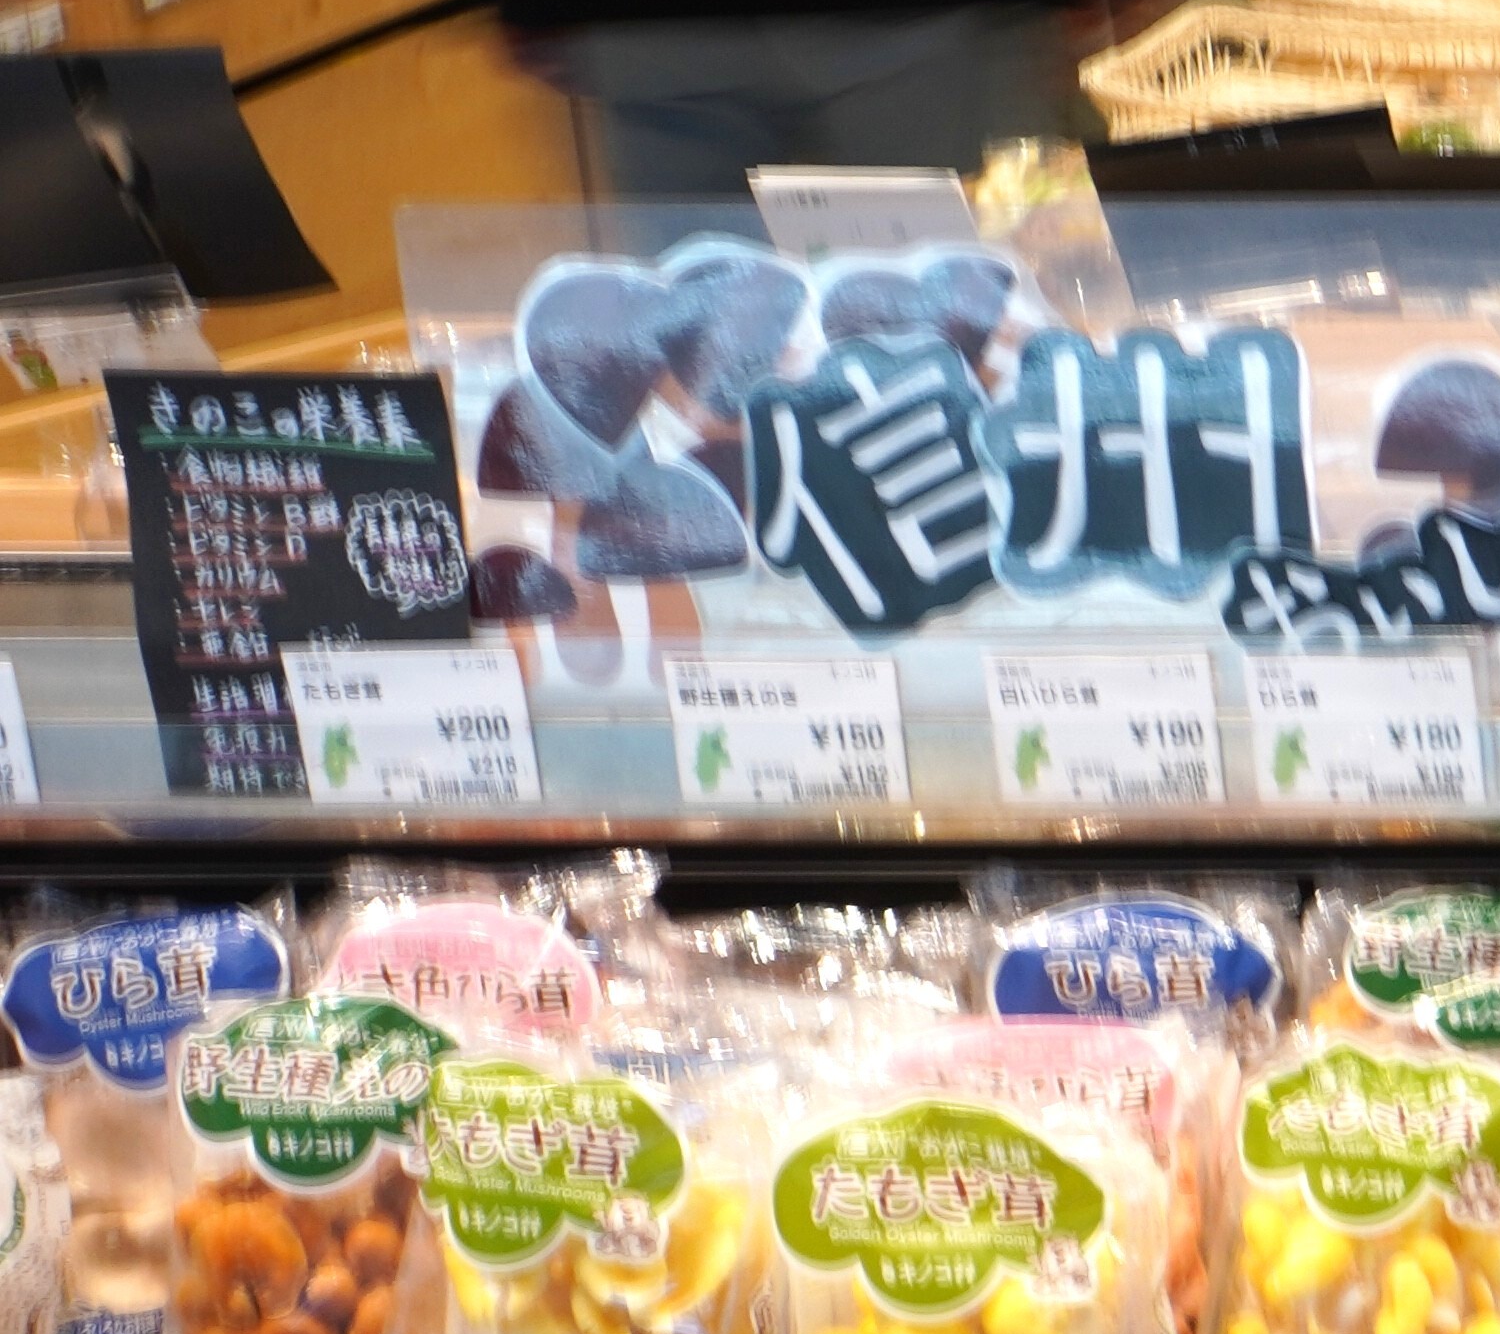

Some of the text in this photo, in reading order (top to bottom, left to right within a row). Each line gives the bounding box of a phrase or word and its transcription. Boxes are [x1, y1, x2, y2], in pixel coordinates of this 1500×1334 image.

[762, 344, 1275, 622] 信州
[301, 679, 385, 703] たもぎ茸
[435, 709, 511, 744] ¥200
[52, 943, 214, 1015] ひら茸
[181, 1042, 431, 1104] 野生種えの
[810, 1164, 1056, 1230] たもぎ茸
